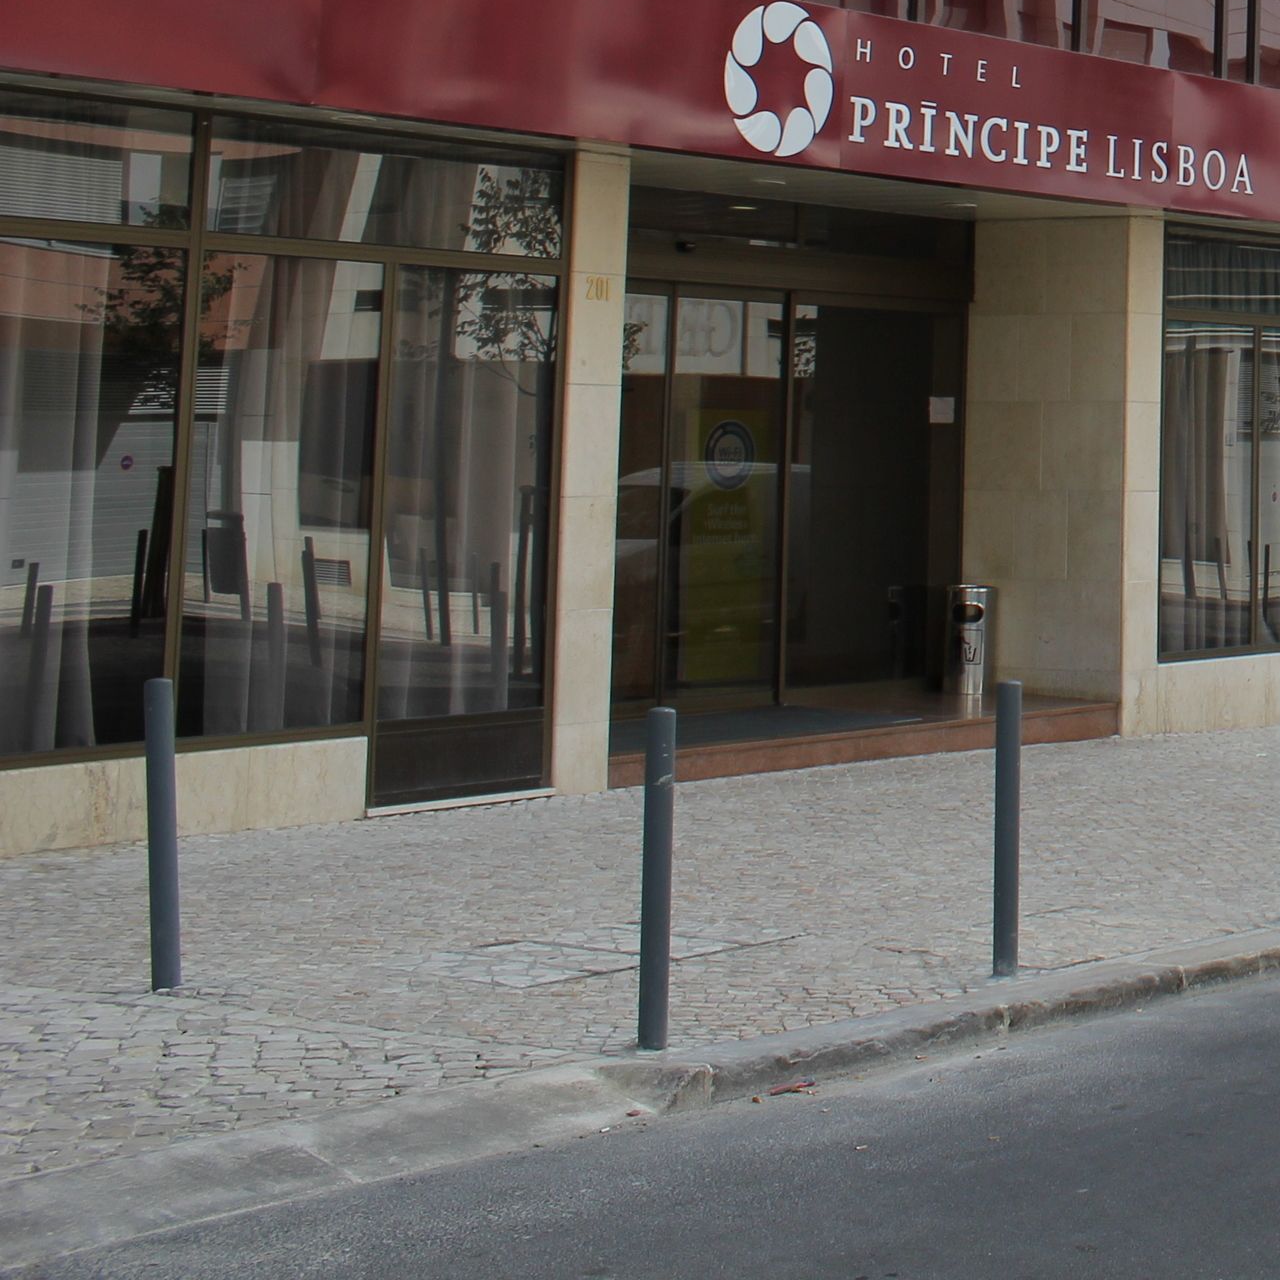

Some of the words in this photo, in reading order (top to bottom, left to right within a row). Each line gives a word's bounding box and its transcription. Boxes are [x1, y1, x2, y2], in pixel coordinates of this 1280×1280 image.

[856, 39, 1021, 88] HOTEL
[1106, 135, 1254, 195] LISBOA
[585, 276, 611, 301] 201
